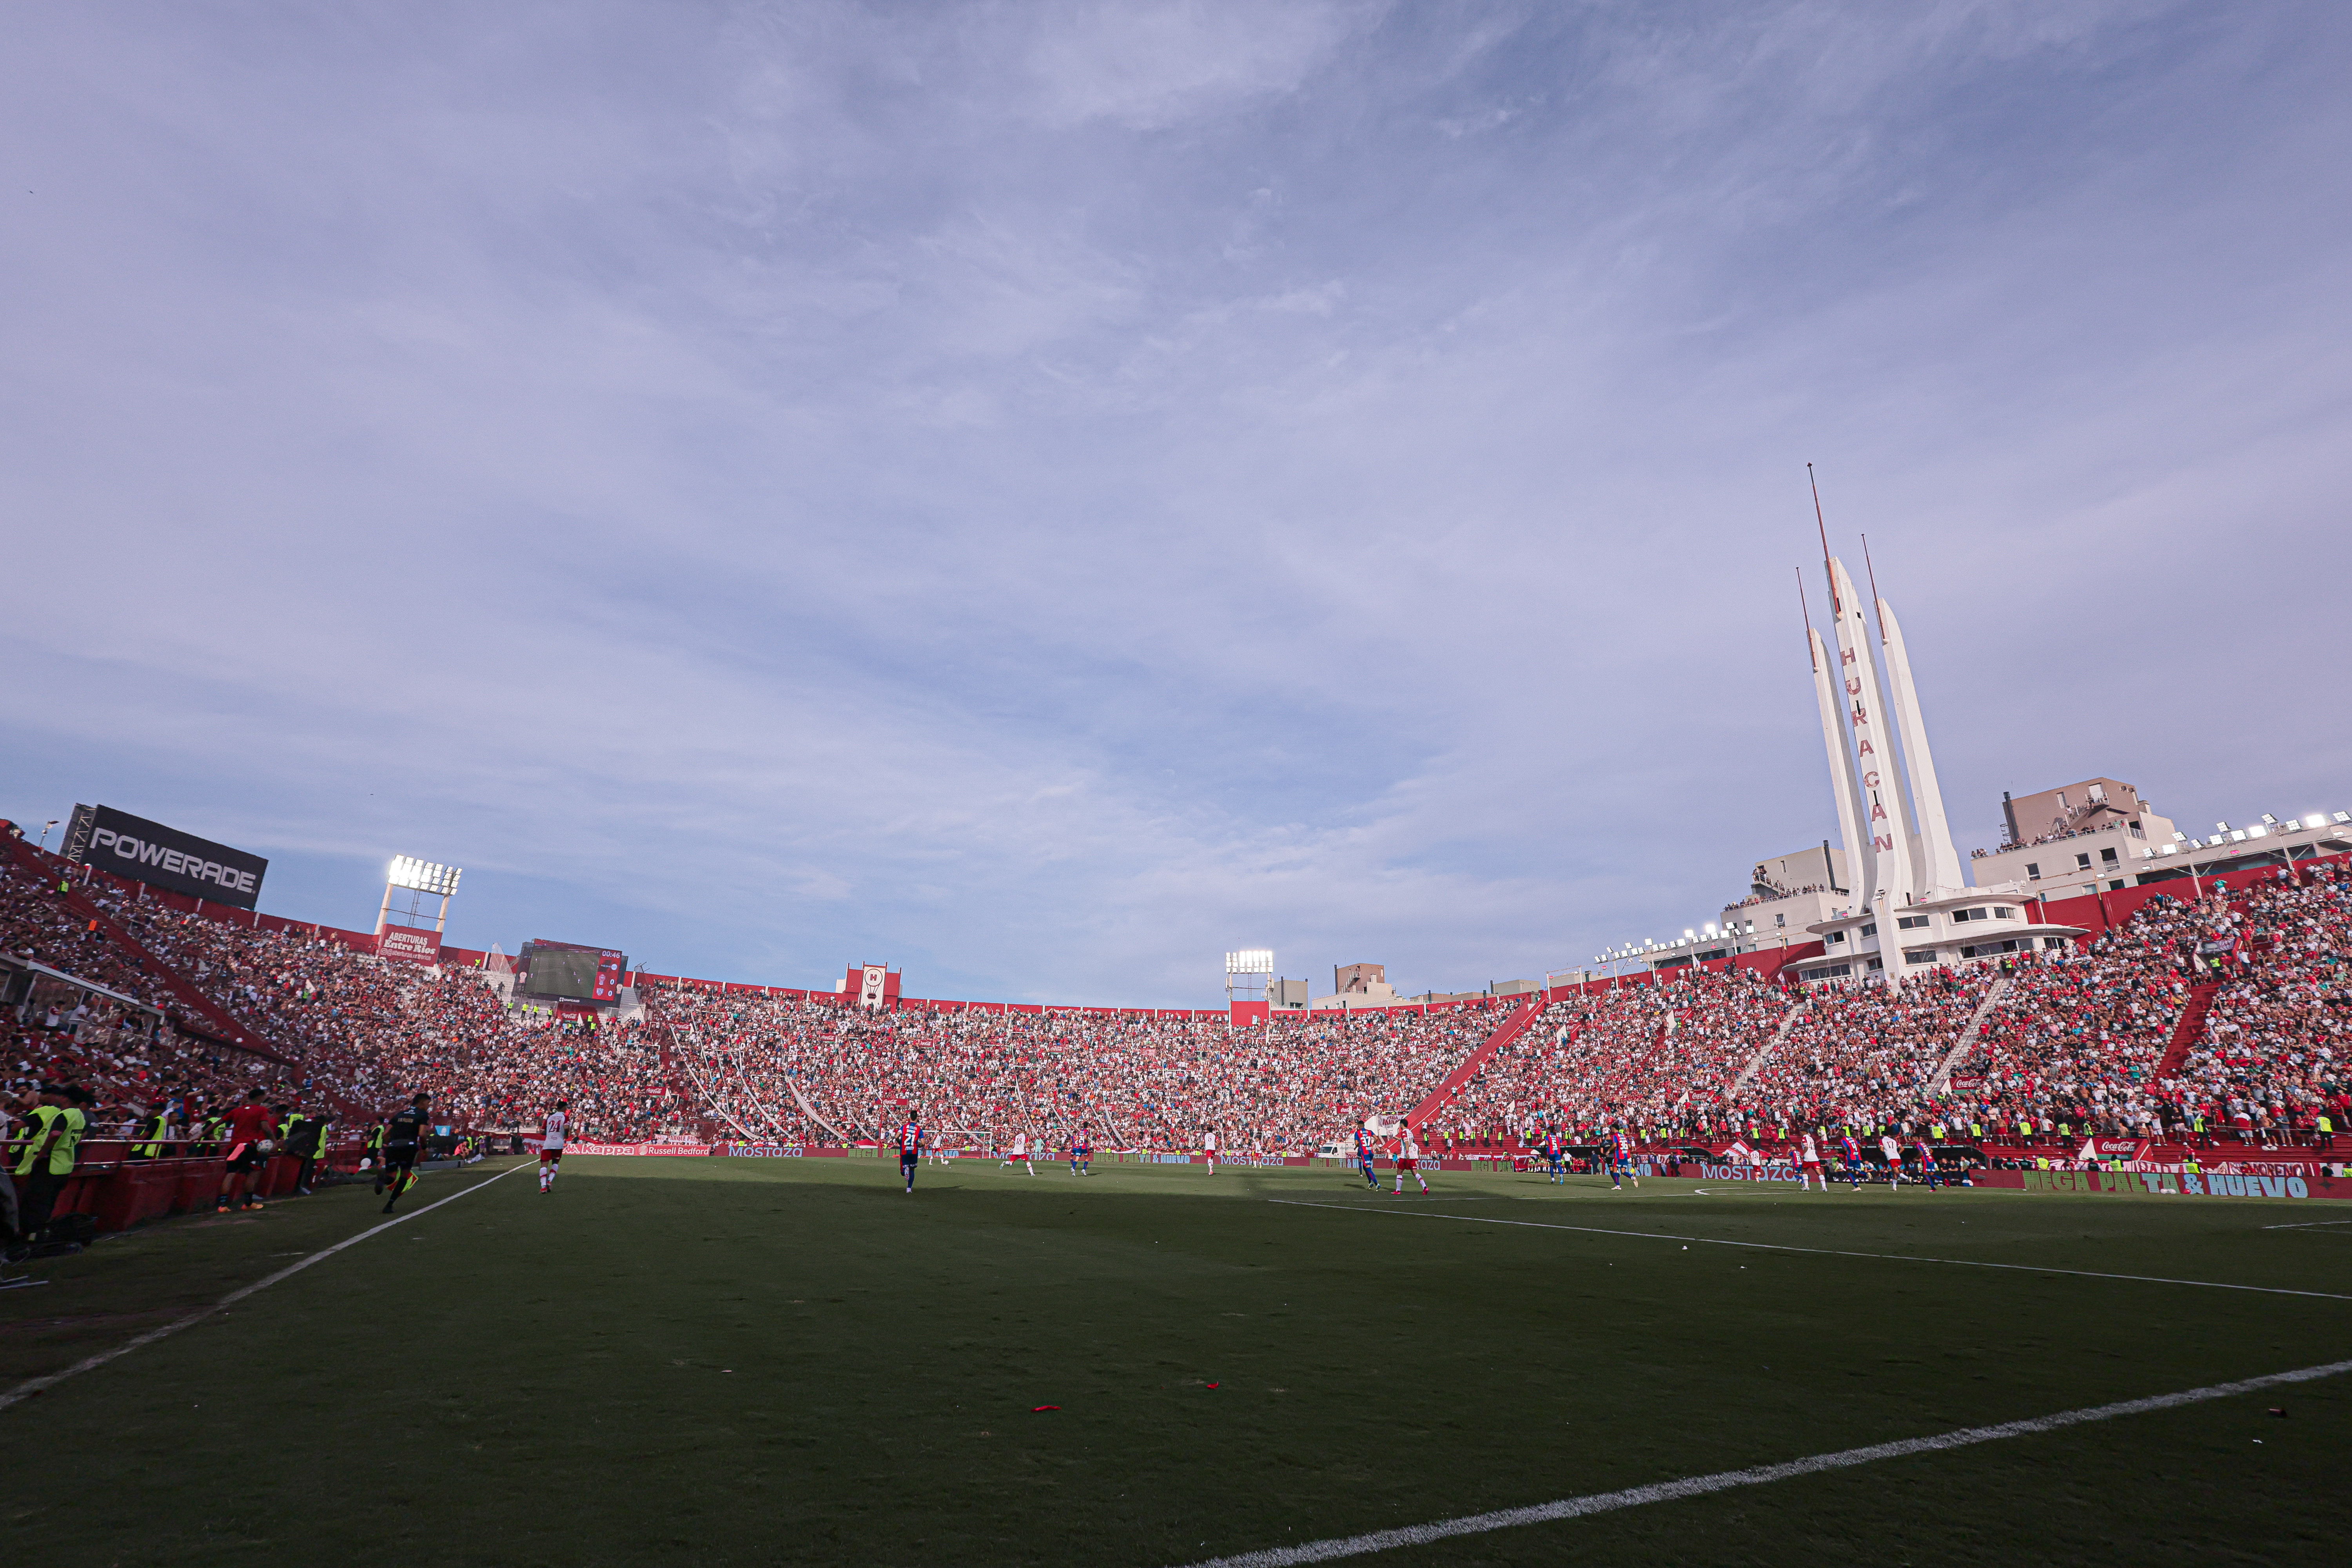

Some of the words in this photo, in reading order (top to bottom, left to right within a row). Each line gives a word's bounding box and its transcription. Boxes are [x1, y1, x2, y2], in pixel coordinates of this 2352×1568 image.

[1840, 647, 1893, 853] HURACAN
[90, 828, 256, 893] POWERADE
[383, 939, 413, 951] Entre
[388, 932, 428, 946] ABERTURAS
[602, 950, 620, 958] 00:46
[549, 1120, 562, 1132] 24
[904, 1133, 916, 1146] 21
[1360, 1136, 1371, 1147] 37
[1619, 1140, 1628, 1150] 36
[581, 1142, 635, 1155] Kappa
[2102, 1141, 2136, 1151] Coca-Cola
[1094, 1153, 1119, 1162] MEGA
[1123, 1154, 1150, 1163] PALTA
[1161, 1154, 1190, 1163] HUEVO
[2183, 1174, 2204, 1194] &
[2207, 1174, 2308, 1198] HUEVO
